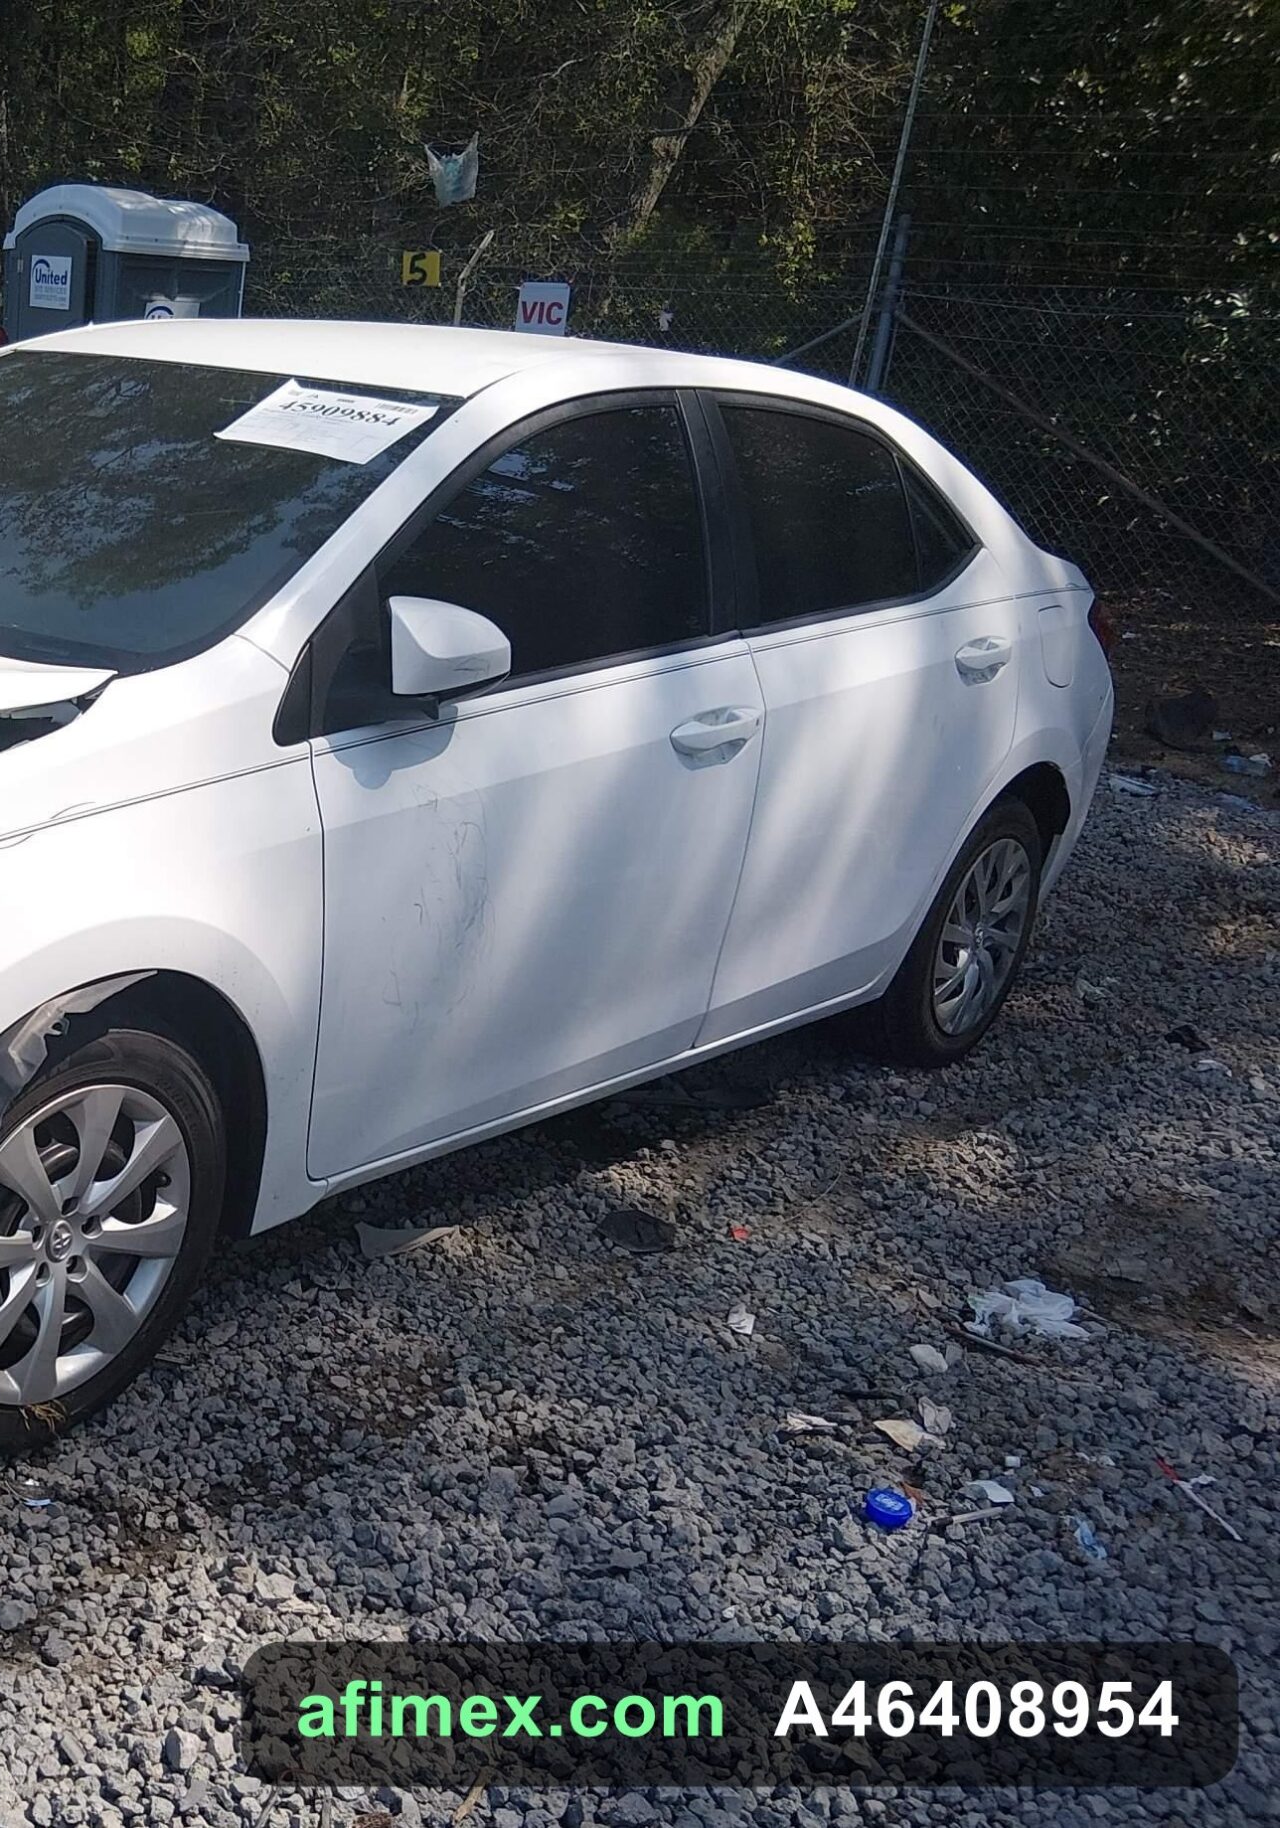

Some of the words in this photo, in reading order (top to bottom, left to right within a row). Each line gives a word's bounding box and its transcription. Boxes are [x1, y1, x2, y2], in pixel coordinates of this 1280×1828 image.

[35, 268, 67, 285] United
[406, 253, 427, 285] 5
[521, 301, 564, 325] VIC
[279, 399, 402, 426] 45909884
